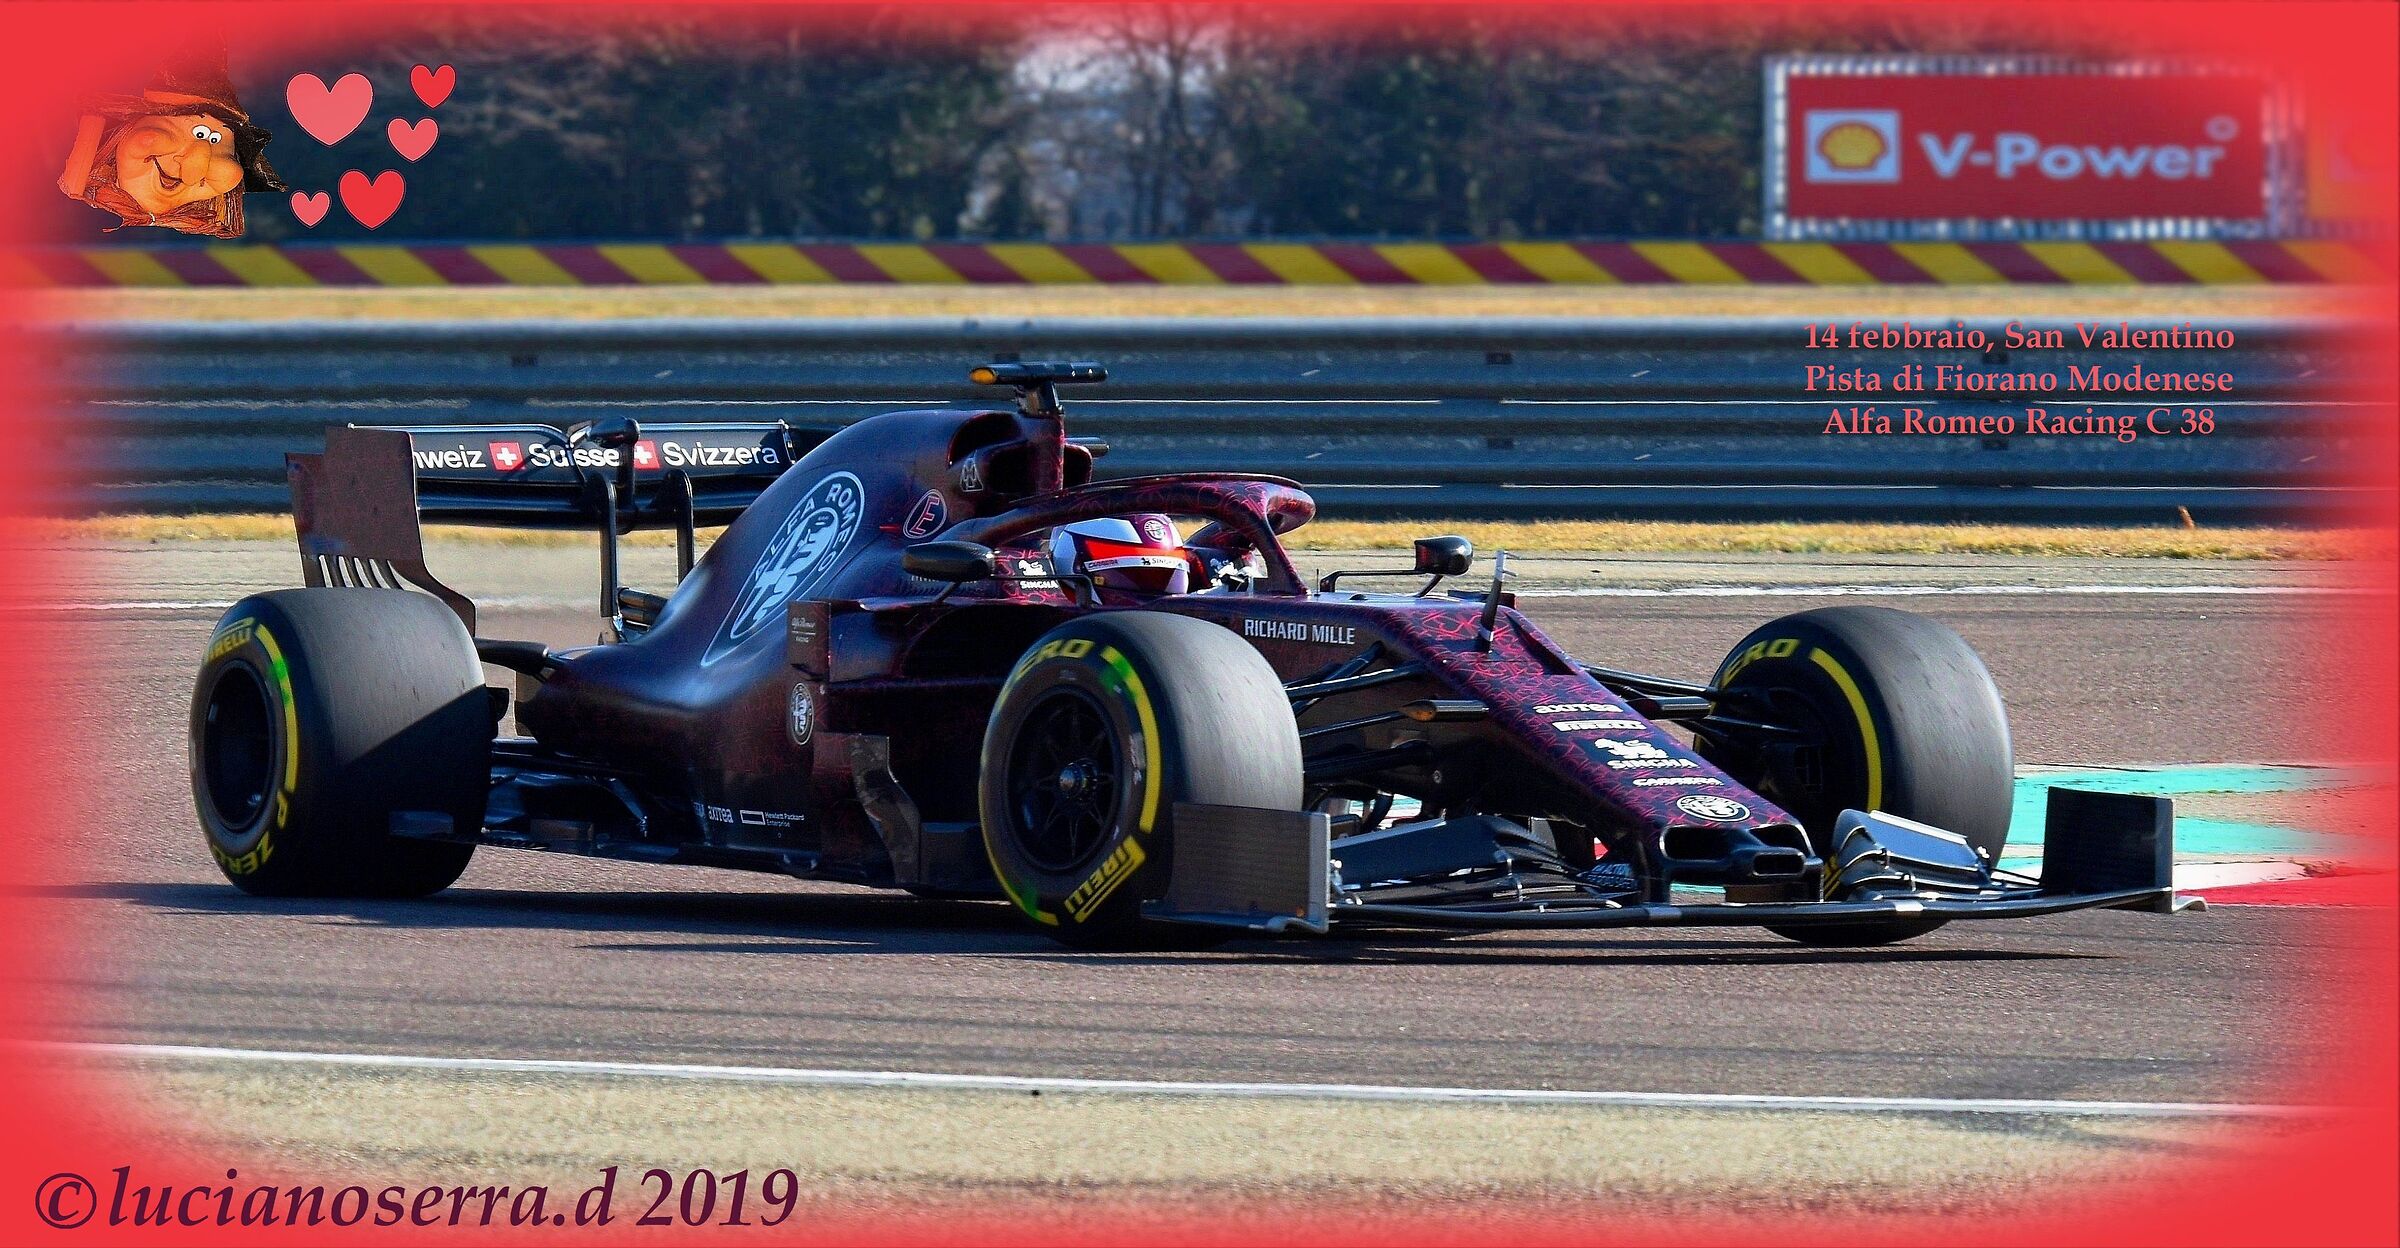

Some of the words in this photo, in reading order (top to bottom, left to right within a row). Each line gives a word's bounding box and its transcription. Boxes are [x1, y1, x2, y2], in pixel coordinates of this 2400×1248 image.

[1918, 132, 2225, 180] V-Power
[528, 442, 620, 468] Suisse
[664, 441, 780, 467] Svizzera
[1244, 619, 1307, 641] RICHARD
[1312, 624, 1356, 645] MILLE
[1607, 758, 1699, 770] SINGHA
[1063, 835, 1147, 924] PIRELLI
